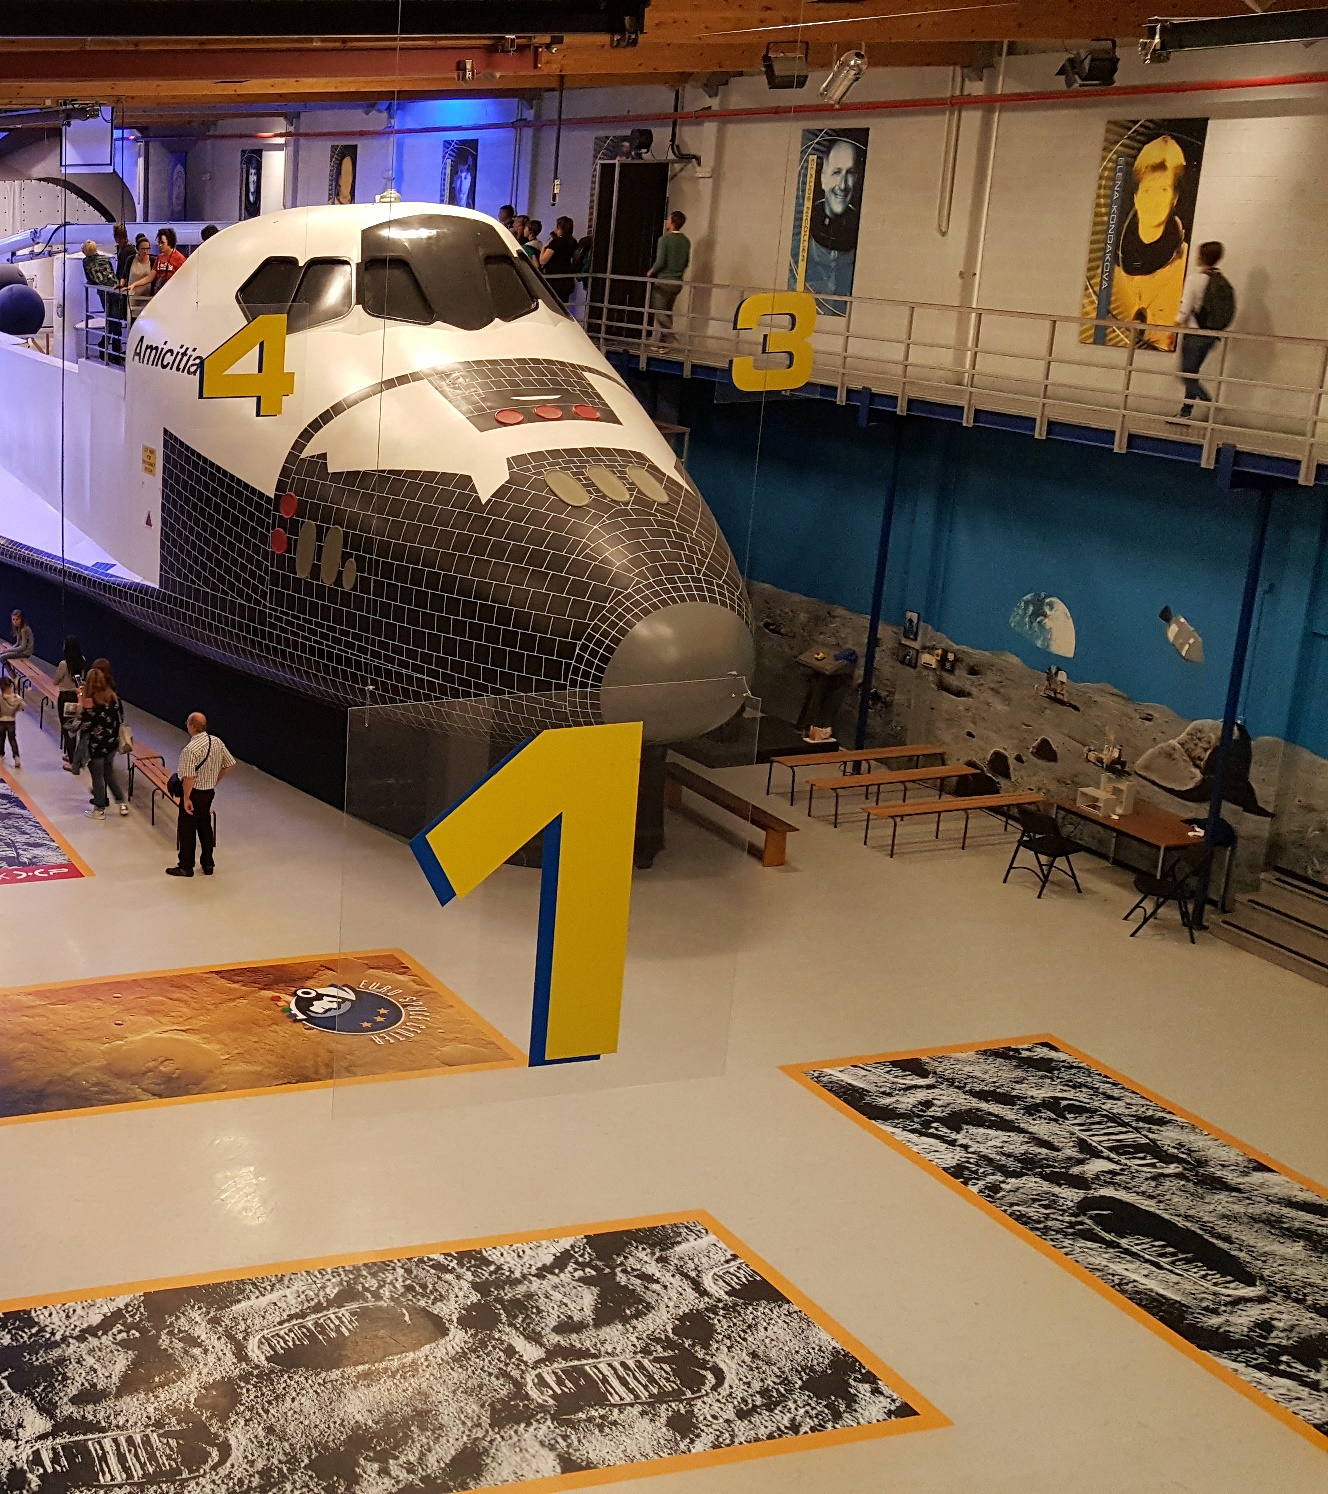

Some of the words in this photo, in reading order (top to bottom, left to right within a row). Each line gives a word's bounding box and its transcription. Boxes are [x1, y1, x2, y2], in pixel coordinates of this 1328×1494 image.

[1112, 157, 1125, 200] ELENA
[1101, 204, 1119, 290] KONDAKOVA
[131, 335, 204, 377] Amicitia
[728, 291, 817, 392] 3
[197, 313, 295, 418] 4
[409, 721, 644, 1067] 1
[359, 979, 403, 996] EURO
[399, 996, 431, 1021] SPACE
[370, 1022, 427, 1046] CENTER
